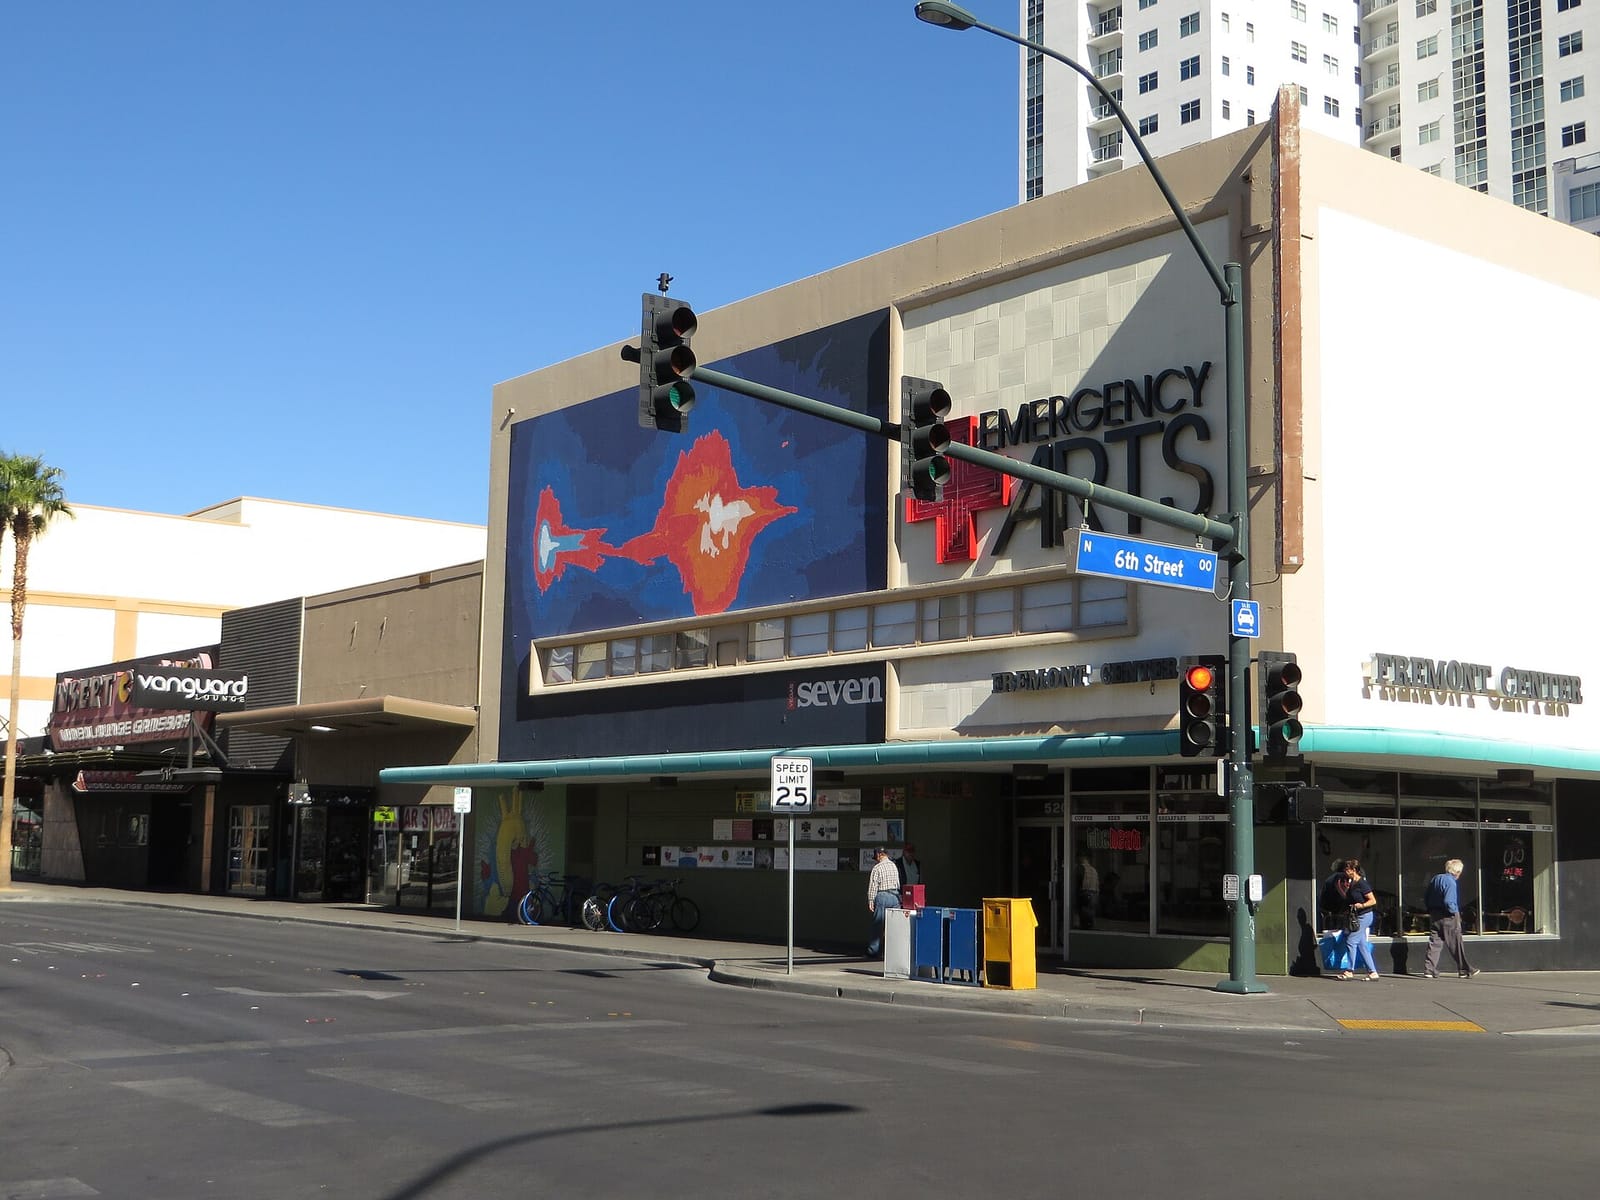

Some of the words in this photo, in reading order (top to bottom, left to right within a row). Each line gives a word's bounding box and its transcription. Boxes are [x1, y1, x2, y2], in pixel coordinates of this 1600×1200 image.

[979, 360, 1211, 450] EMERGENCY
[990, 413, 1214, 556] ARTS
[1084, 540, 1092, 552] N
[1114, 549, 1139, 571] 6th
[1144, 554, 1184, 577] Street
[56, 673, 116, 712] INSERT
[137, 674, 248, 699] vanguard
[797, 676, 883, 707] seven
[991, 664, 1090, 694] FREMONT
[1100, 657, 1179, 684] CENTER
[1374, 652, 1492, 693] FREMONT
[1499, 666, 1583, 704] CENTER
[195, 694, 245, 702] LOUNGE
[776, 763, 808, 773] SPEED
[780, 775, 804, 784] LIMIT
[776, 786, 807, 806] 25
